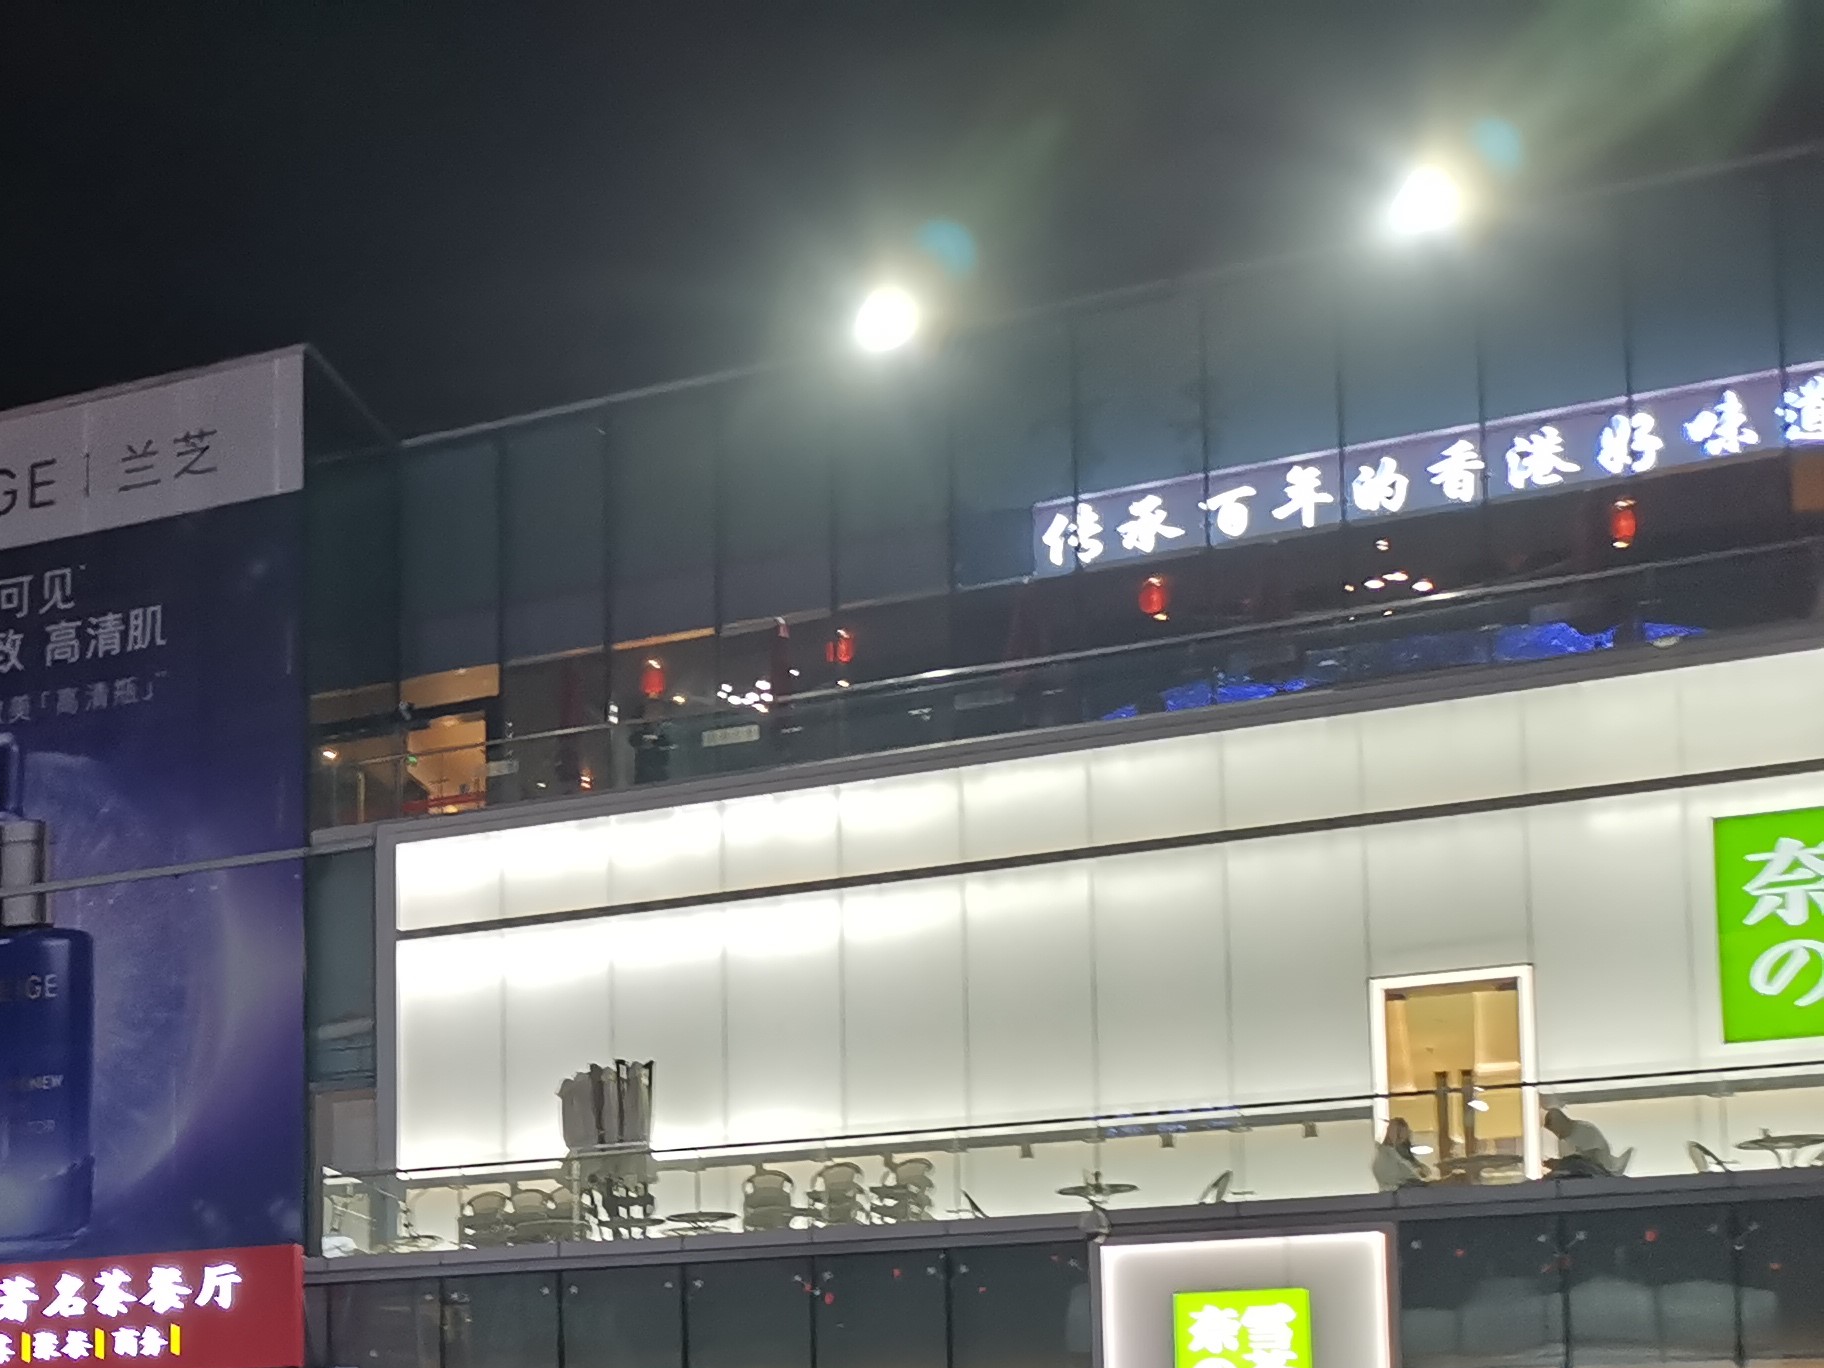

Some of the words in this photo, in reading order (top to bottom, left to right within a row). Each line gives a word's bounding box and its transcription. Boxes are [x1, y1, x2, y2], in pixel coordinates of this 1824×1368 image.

[119, 429, 217, 493] 兰芝
[1042, 376, 1824, 568] 传承百年的香港好味道
[44, 604, 167, 667] 高清肌
[1187, 1302, 1297, 1354] 奈雪
